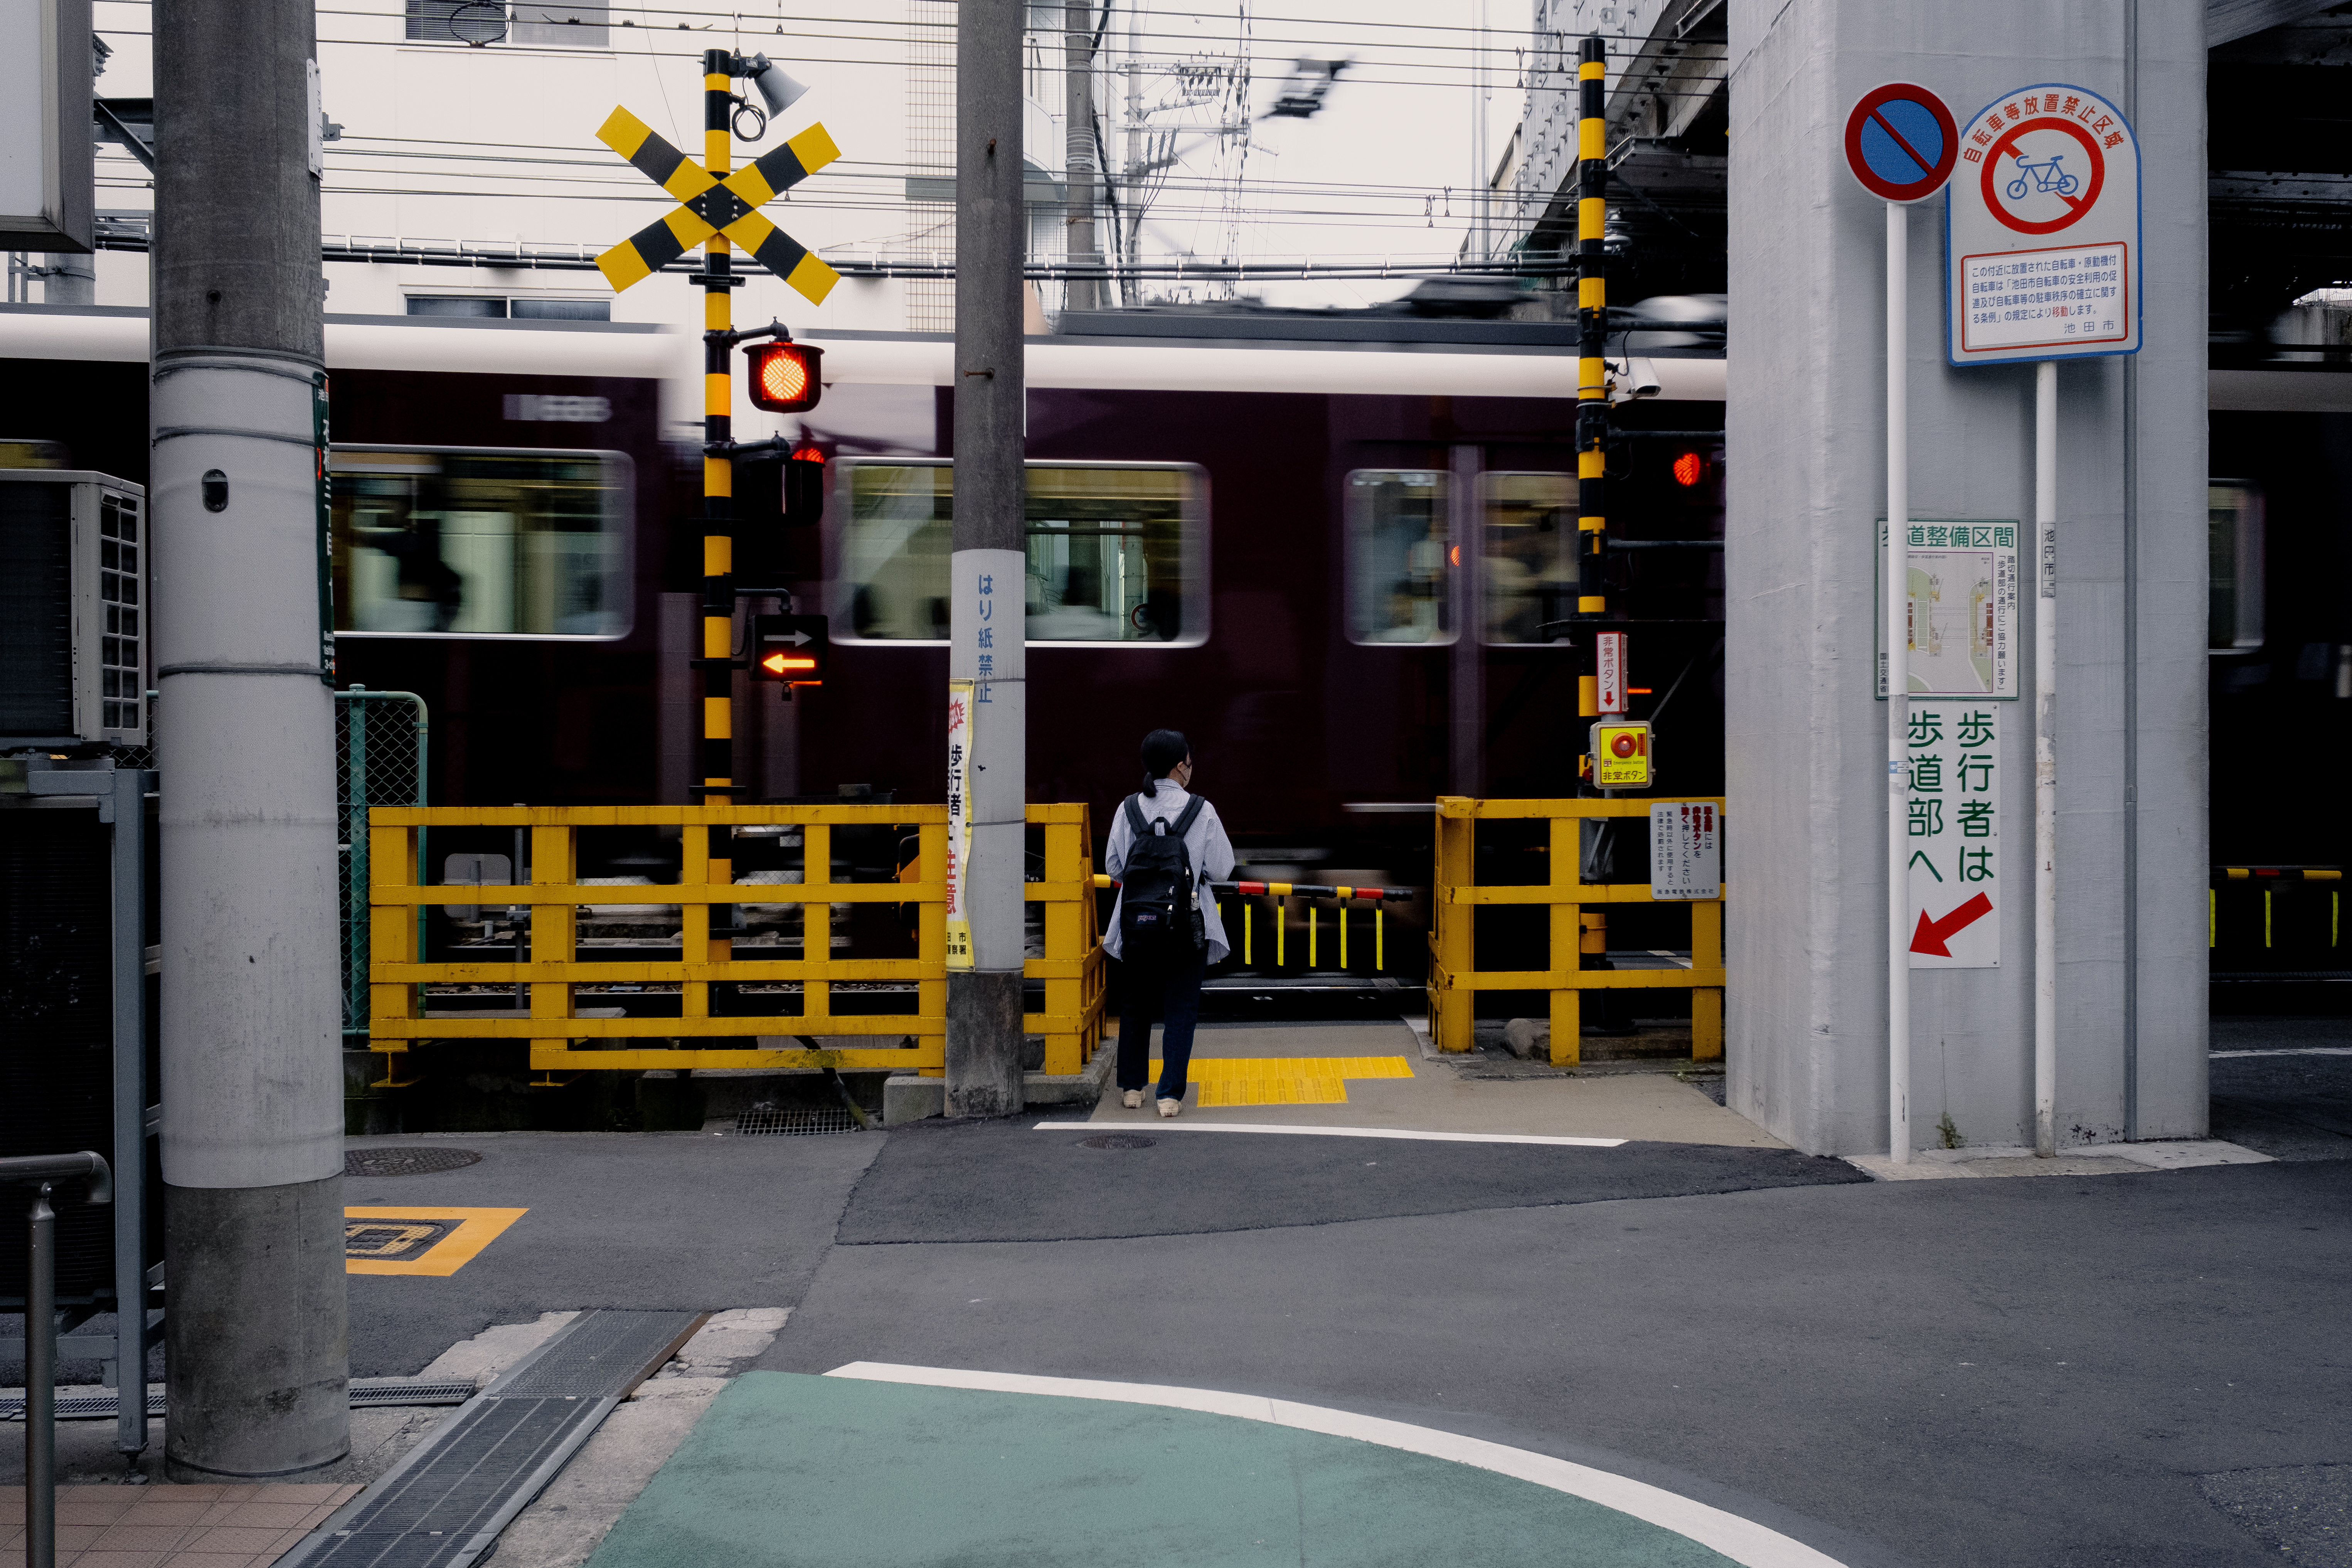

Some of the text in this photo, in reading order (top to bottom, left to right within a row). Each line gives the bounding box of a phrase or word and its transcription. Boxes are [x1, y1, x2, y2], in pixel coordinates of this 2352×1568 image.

[1963, 94, 2124, 163] 自転車等放置禁止区域
[1972, 254, 2116, 277] この付近に放置された自転車・原動機付
[1972, 270, 2116, 293] 自転車は「池田市自転車の安全利用の促
[1972, 286, 2116, 308] 進及び自転車等の駐車秩序の確立に関す
[1973, 305, 2097, 323] る条例」の規定により移動します。
[2064, 320, 2114, 334] 池田市
[1882, 525, 2014, 548] 道整備区間
[978, 574, 993, 703] はり紙禁止
[1603, 636, 1613, 690] 非常ボタン
[951, 744, 963, 816] 歩行者
[1603, 770, 1646, 780] 非常ボタン
[1908, 710, 1943, 883] 歩道部へ
[1956, 710, 1995, 883] 歩行者は
